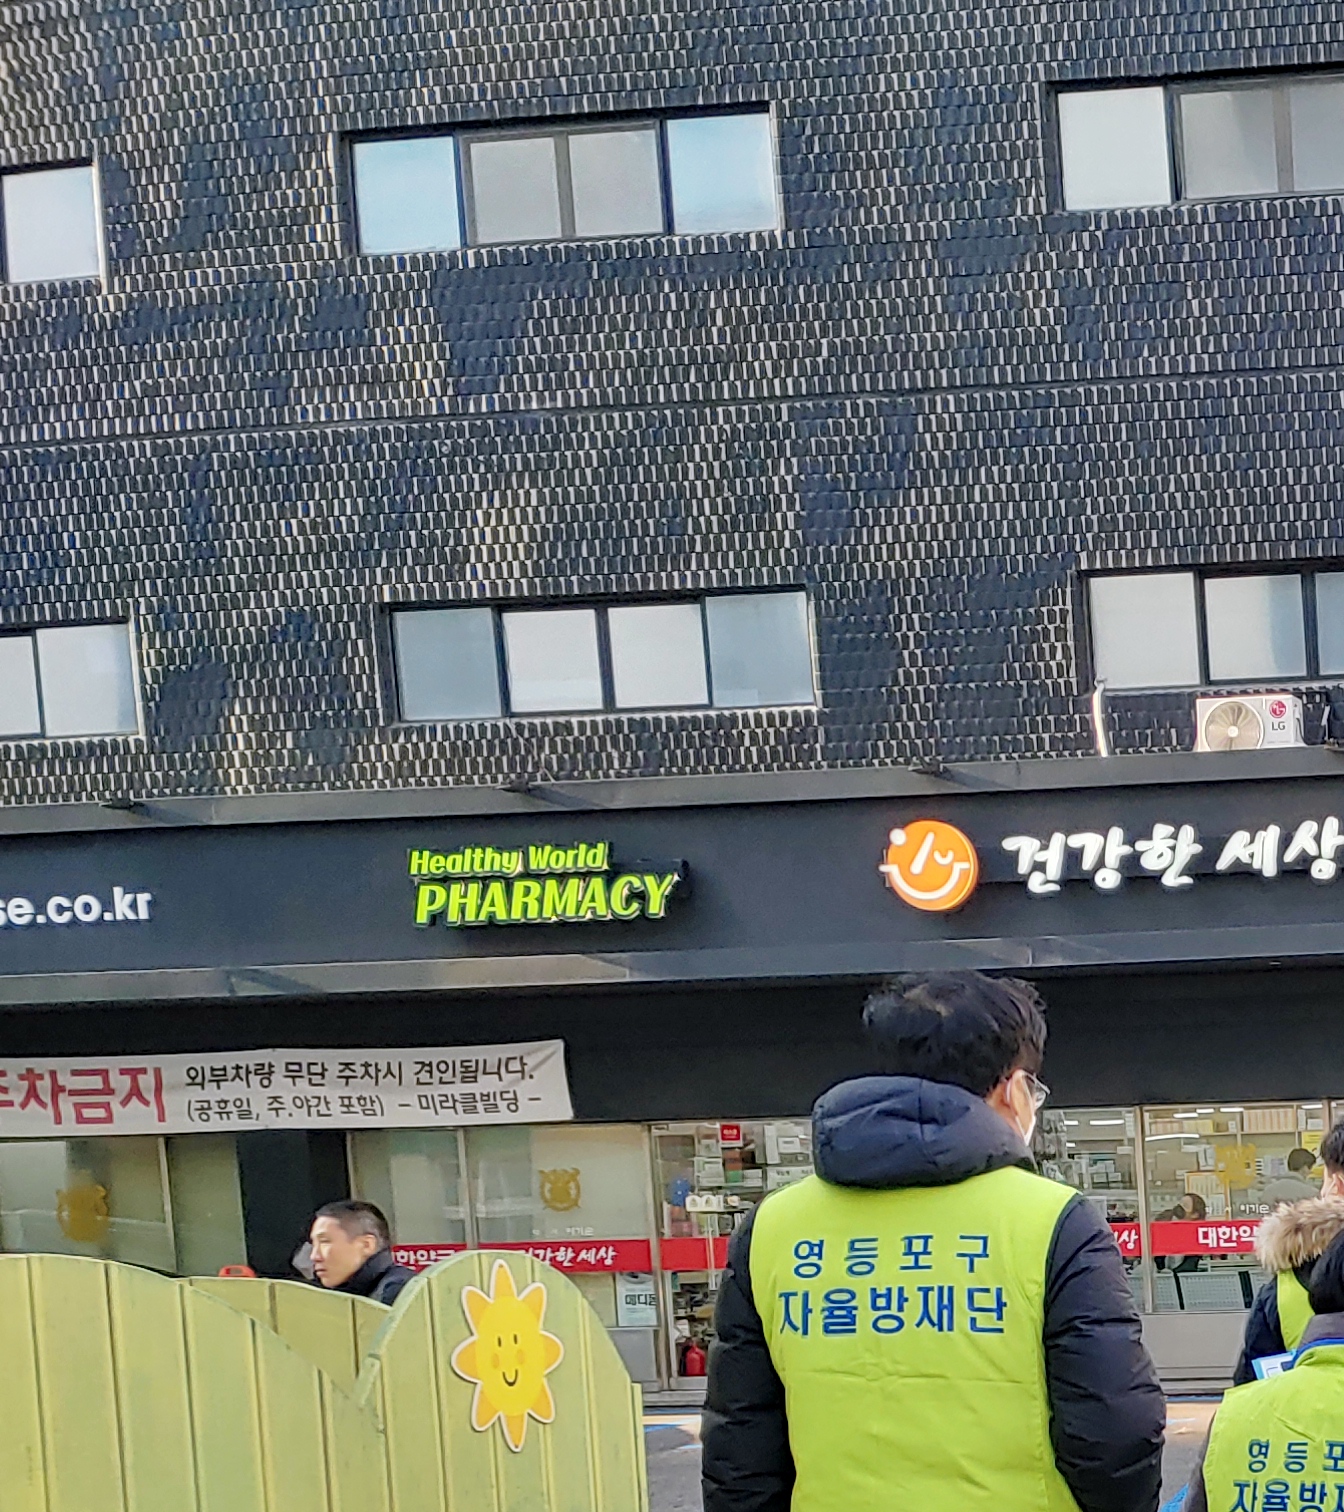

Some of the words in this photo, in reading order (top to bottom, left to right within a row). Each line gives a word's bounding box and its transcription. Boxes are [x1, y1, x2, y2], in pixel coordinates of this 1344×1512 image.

[1271, 721, 1286, 731] LG
[409, 846, 521, 876] Healthy
[528, 842, 608, 871] World
[1001, 822, 1203, 895] 건강한
[0, 886, 153, 926] e.co.kr
[415, 873, 676, 925] PHARMACY
[185, 1061, 275, 1091] 외부차량
[282, 1060, 328, 1088] 무단
[336, 1060, 403, 1087] 주차시
[413, 1055, 535, 1086] 견인됩니다.
[338, 1093, 385, 1118] 포함)
[418, 1089, 520, 1116] 미라클빌딩
[793, 1234, 990, 1279] 영등포구
[778, 1284, 1008, 1337] 자율방재단
